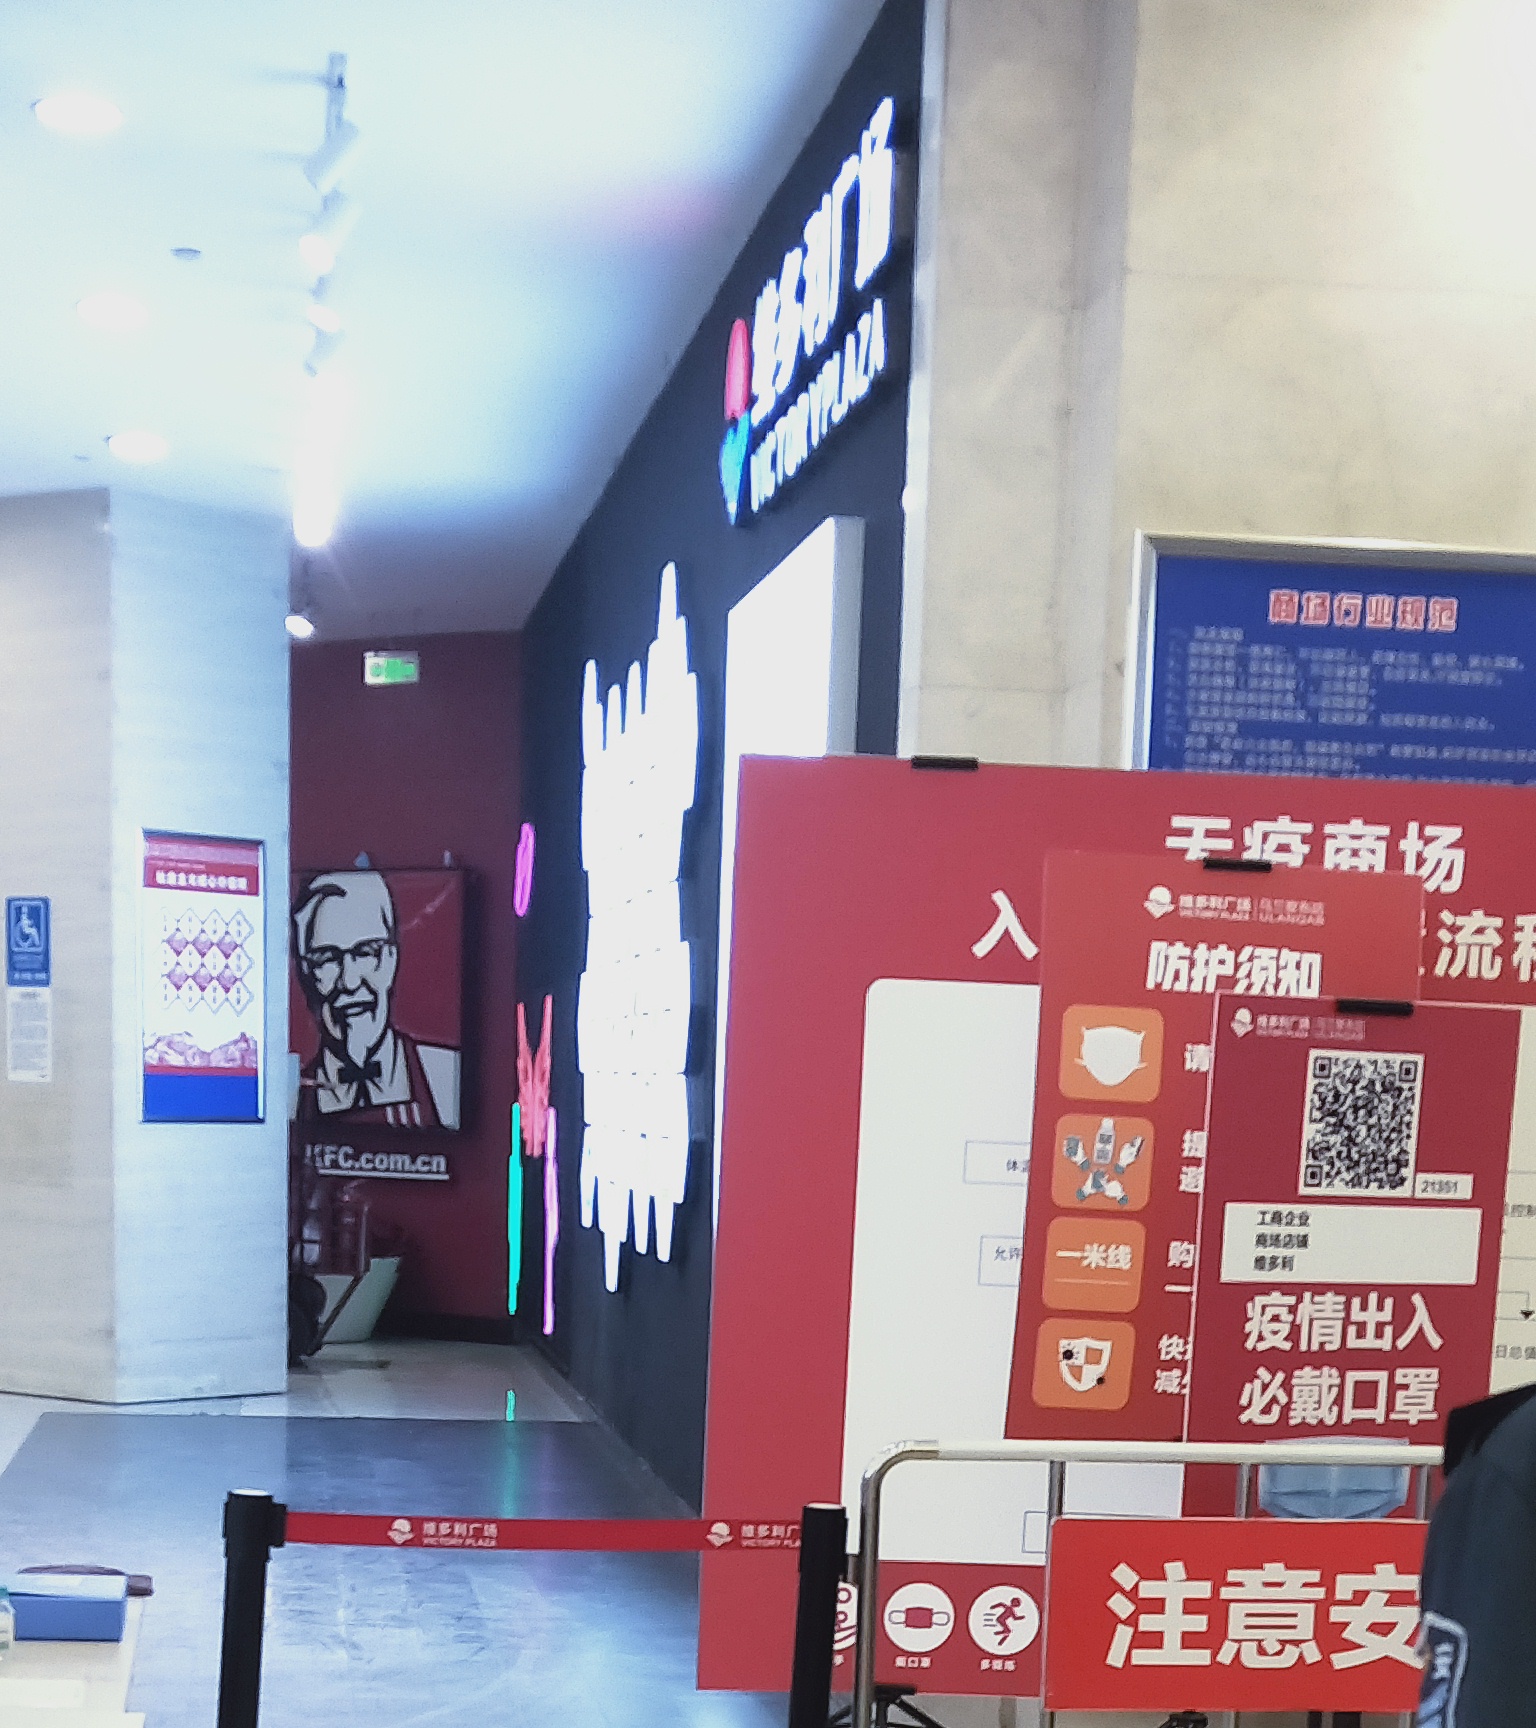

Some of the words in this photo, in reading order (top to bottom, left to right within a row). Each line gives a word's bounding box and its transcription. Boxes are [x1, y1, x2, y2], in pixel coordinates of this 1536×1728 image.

[1145, 939, 1323, 998] 防护须知
[1056, 1242, 1133, 1270] 一米线
[1244, 1290, 1444, 1352] 疫情出入
[1238, 1365, 1440, 1426] 必戴口罩
[1105, 1560, 1424, 1671] 注意安
